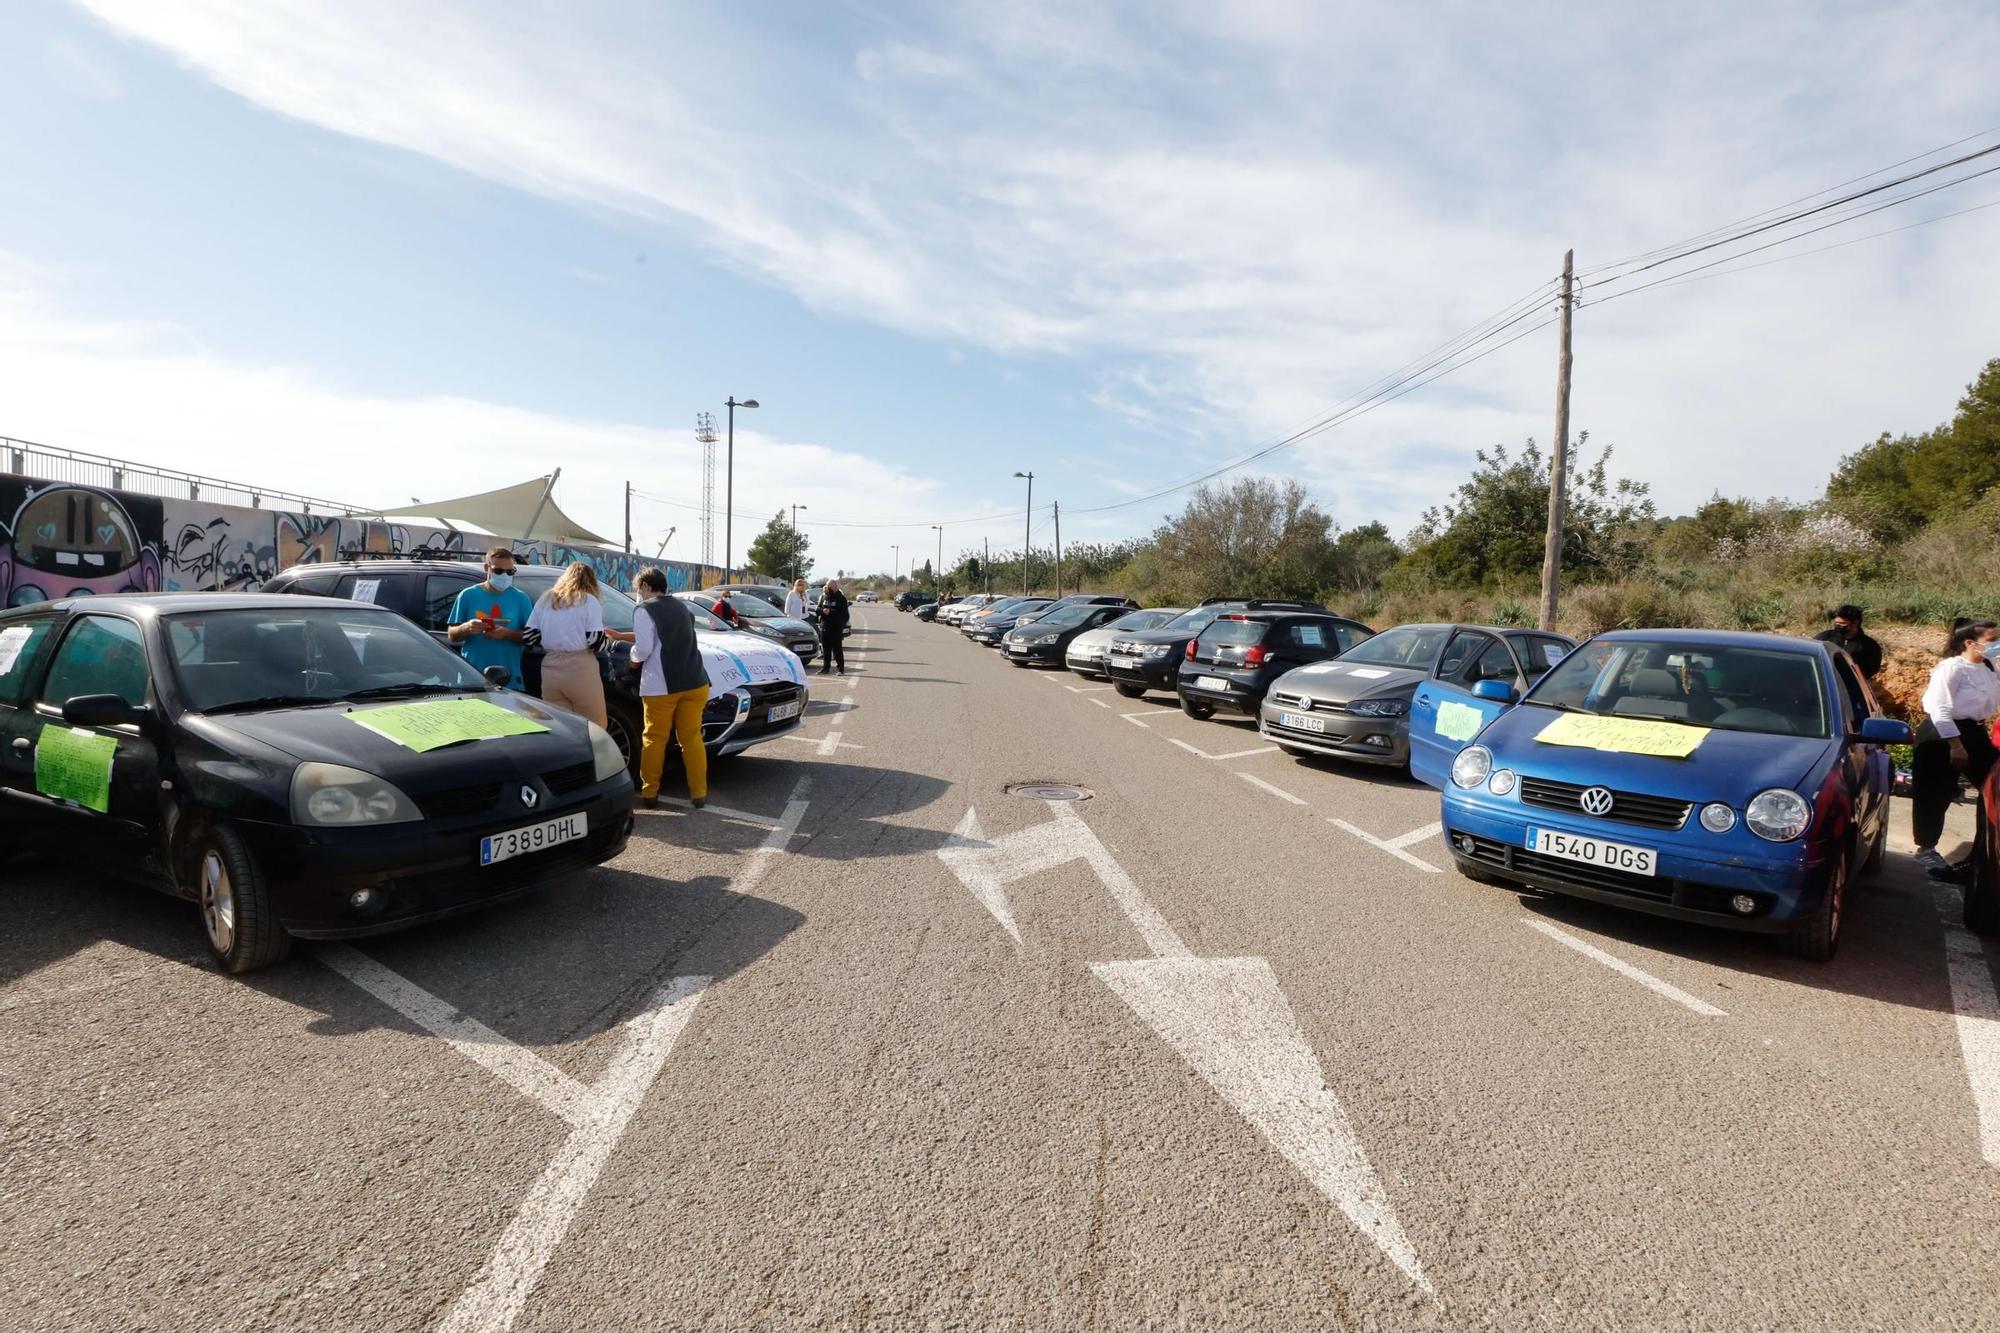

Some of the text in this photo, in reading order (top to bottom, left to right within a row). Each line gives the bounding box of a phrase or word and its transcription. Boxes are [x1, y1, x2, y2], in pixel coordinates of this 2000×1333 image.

[1286, 715, 1322, 730] 3166 LCC
[494, 828, 543, 859] 7389
[548, 818, 581, 844] DHL
[1545, 833, 1596, 860] 1540
[1605, 845, 1650, 871] DGS
